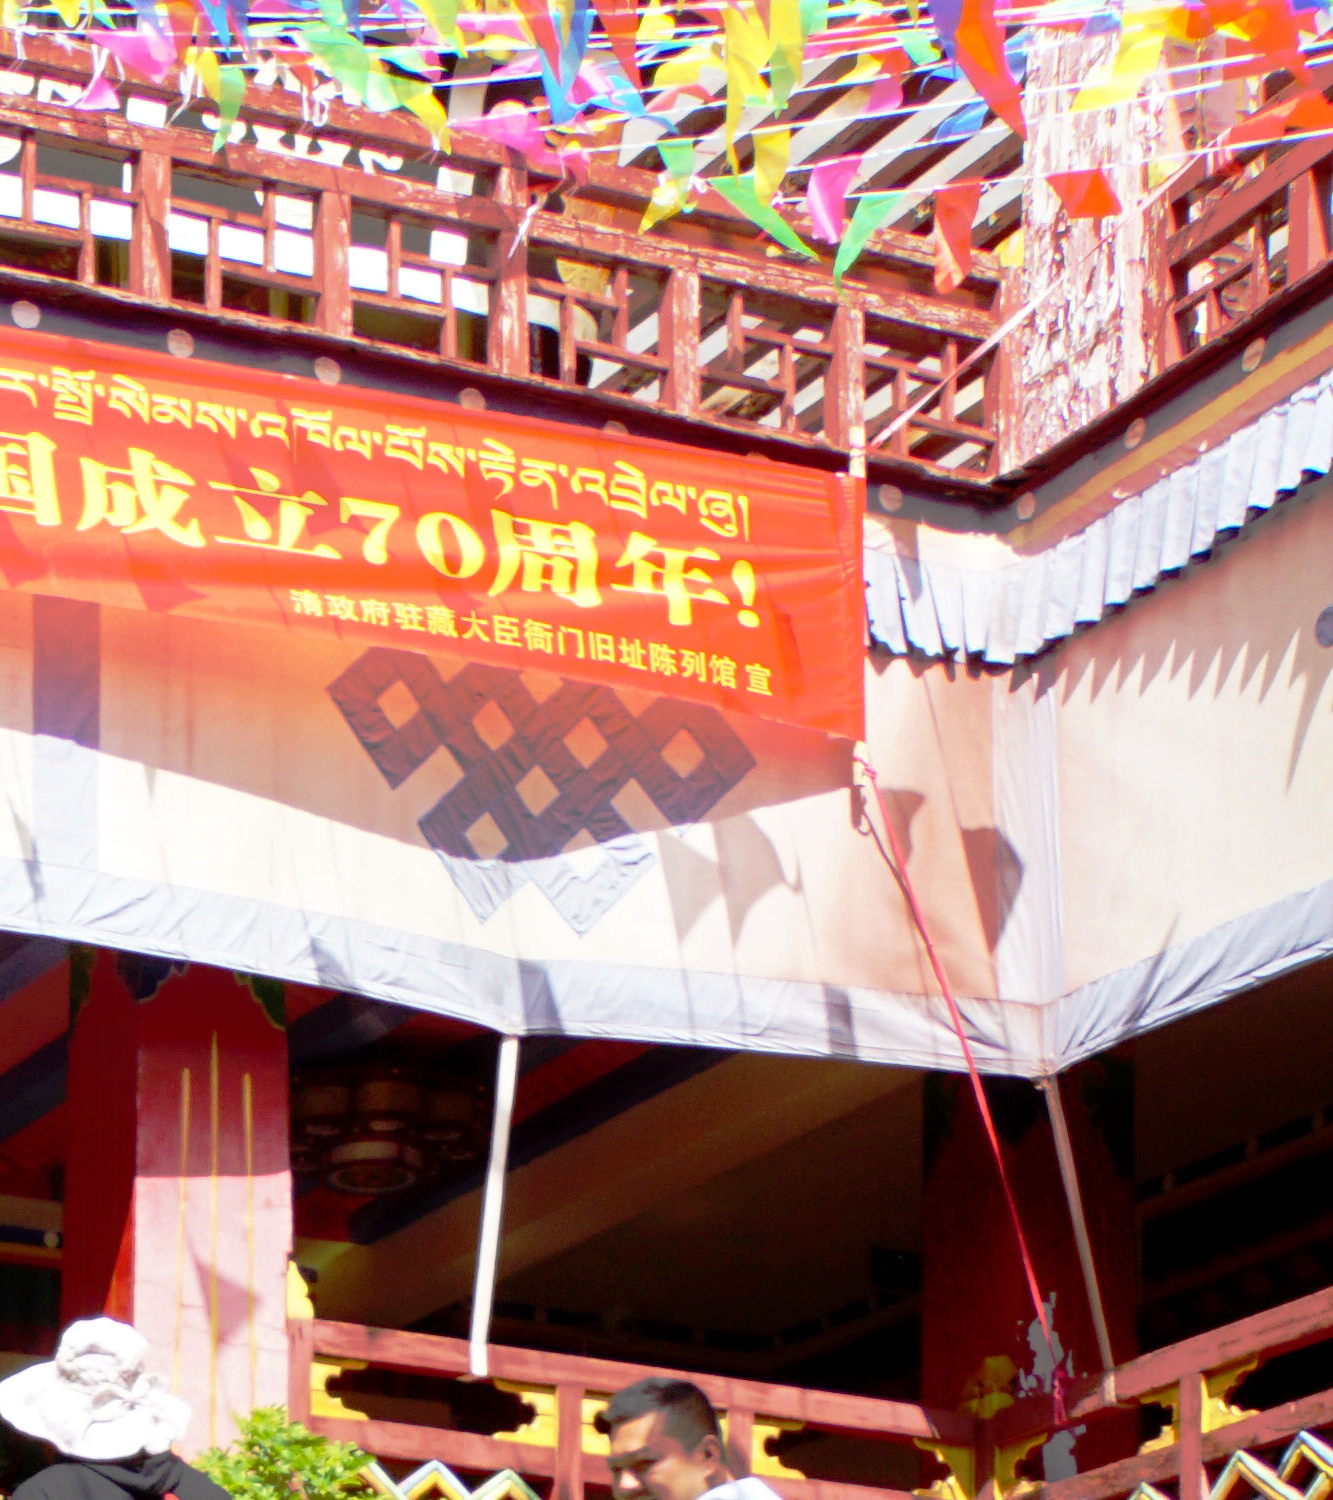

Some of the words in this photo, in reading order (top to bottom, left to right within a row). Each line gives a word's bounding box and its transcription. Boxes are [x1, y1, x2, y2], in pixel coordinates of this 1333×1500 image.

[290, 588, 739, 690] 清政府驻藏大臣衙门旧址陈列馆
[746, 662, 774, 696] 宣
